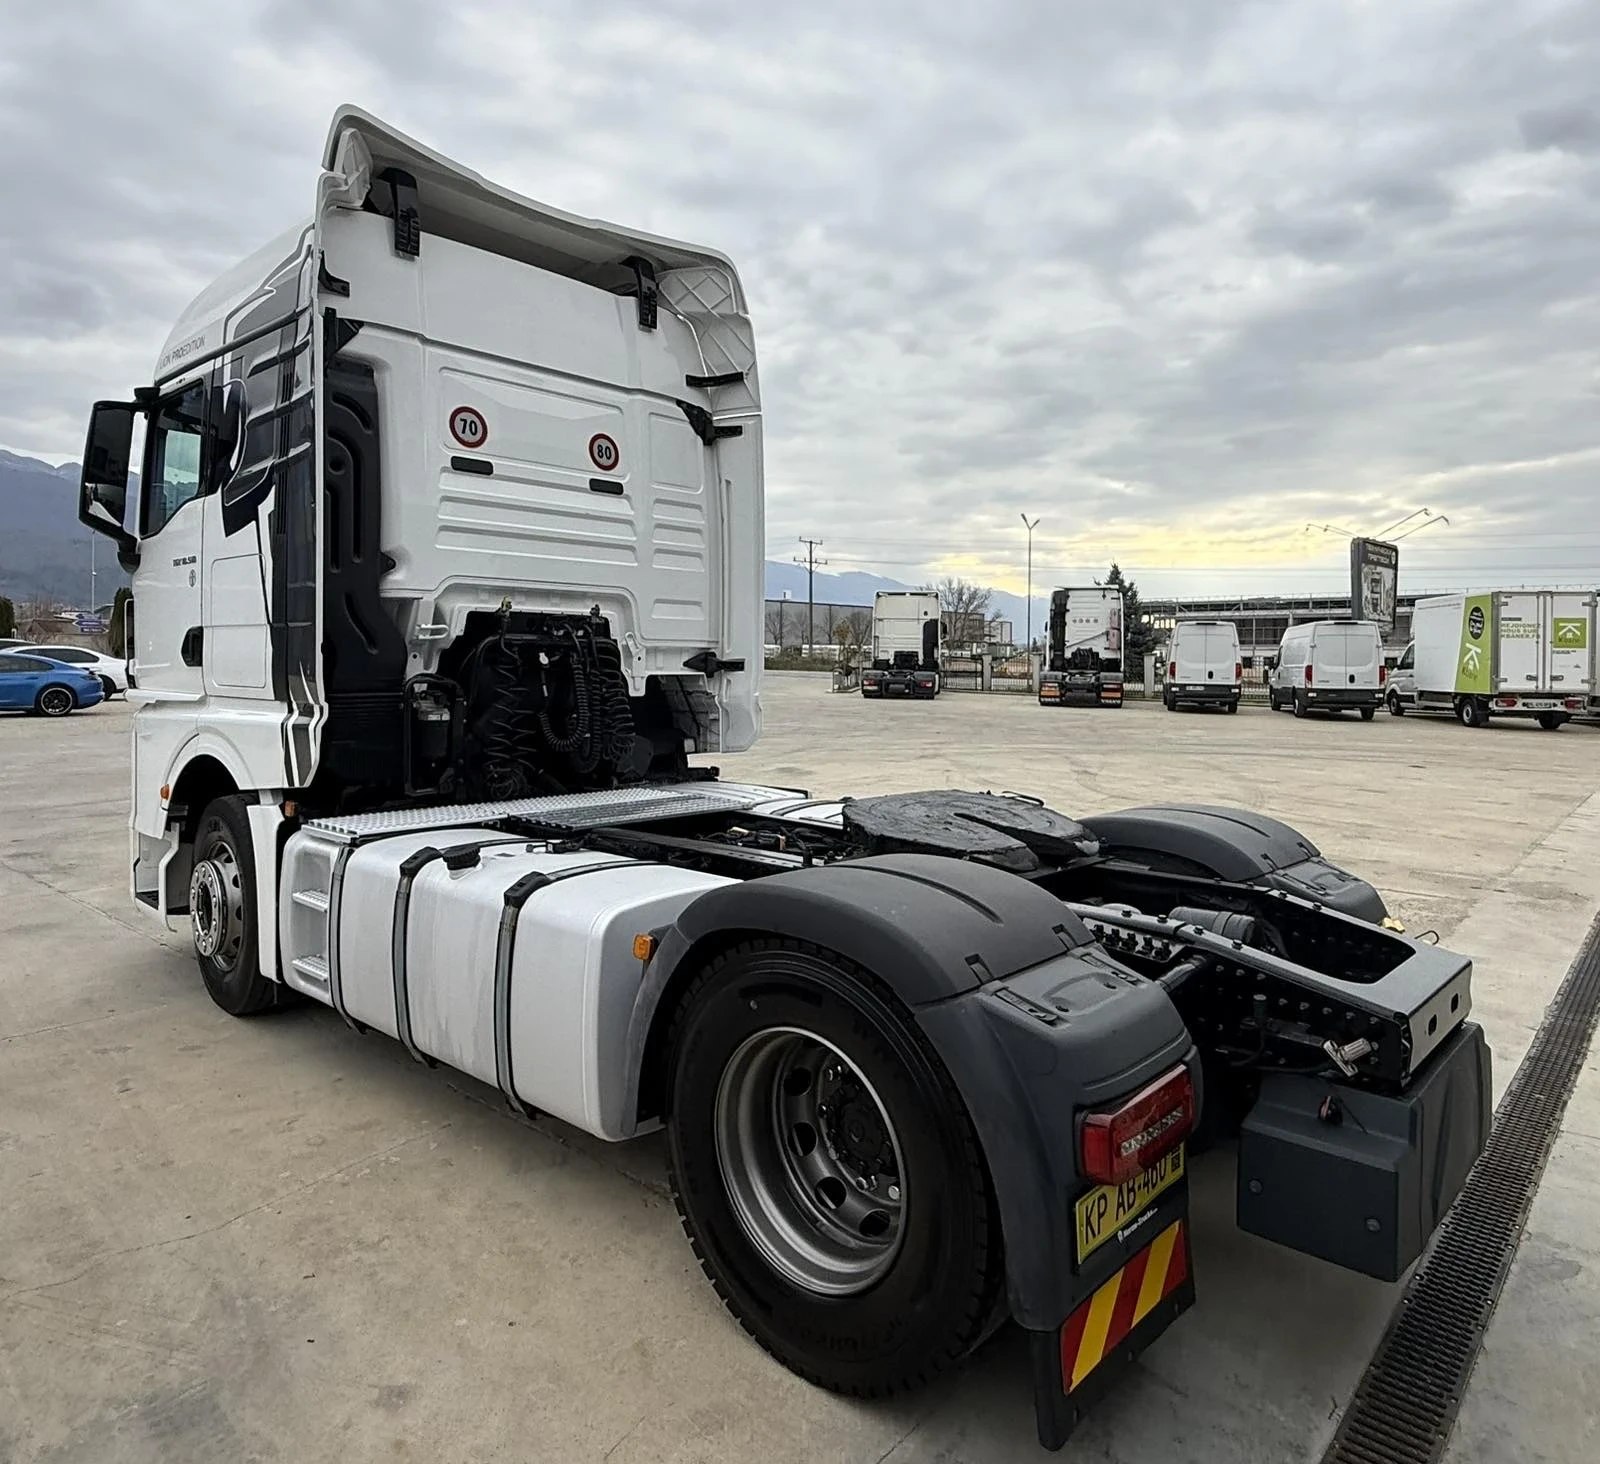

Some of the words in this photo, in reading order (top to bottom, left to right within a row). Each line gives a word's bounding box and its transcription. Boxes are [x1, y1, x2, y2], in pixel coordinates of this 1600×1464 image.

[459, 417, 478, 436] 70
[596, 443, 612, 461] 80
[1085, 1193, 1107, 1244] KP
